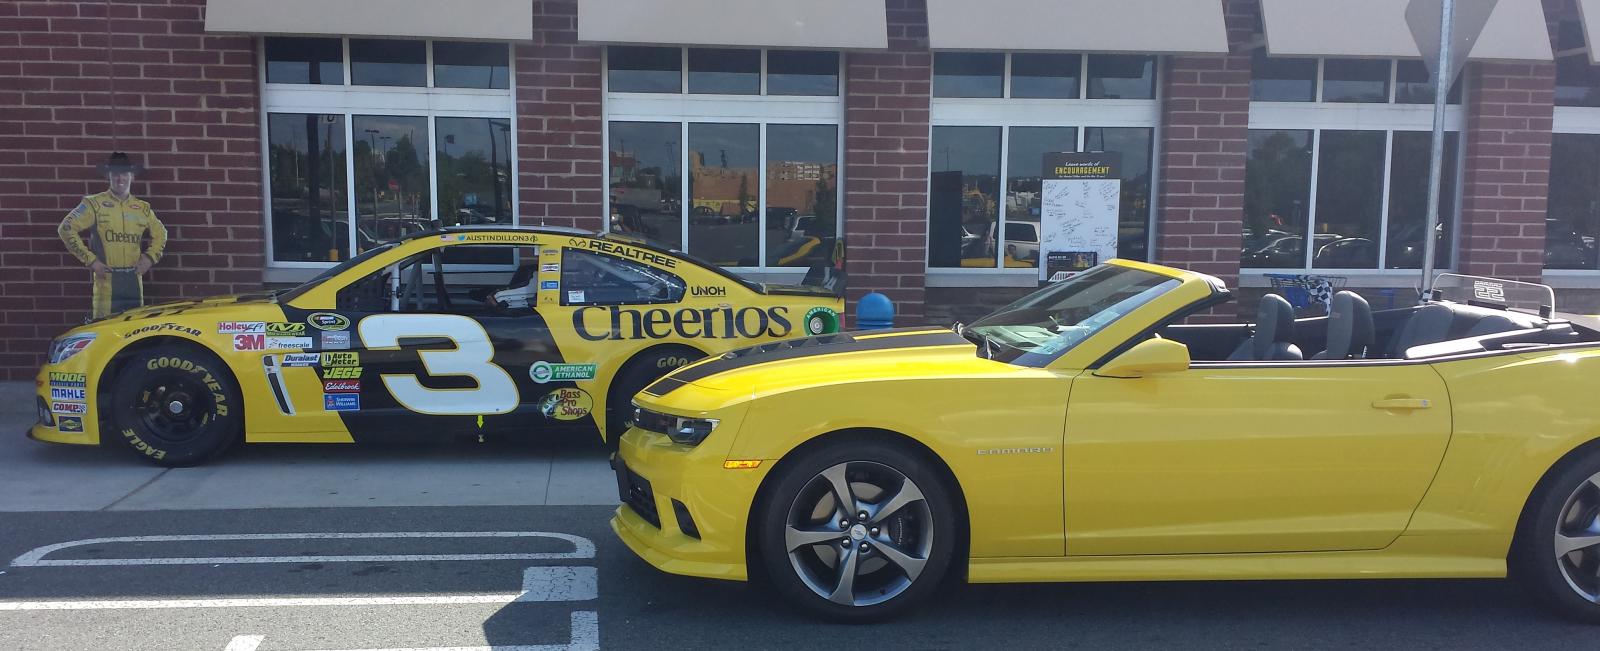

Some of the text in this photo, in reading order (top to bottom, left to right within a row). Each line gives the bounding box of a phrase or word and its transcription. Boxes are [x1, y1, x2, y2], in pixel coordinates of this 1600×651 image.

[1055, 166, 1110, 174] ENCOURAGEMENT
[589, 240, 677, 268] REALTREE
[691, 286, 726, 296] UNOH
[806, 306, 836, 319] AMERICAN
[219, 322, 249, 332] Holley
[572, 304, 793, 342] Cheerios
[234, 334, 265, 350] 3M
[284, 354, 318, 362] Duralast
[358, 313, 521, 416] 3
[50, 372, 86, 382] MOOG
[323, 367, 363, 379] JEGS
[325, 382, 360, 390] Edelbrock
[51, 388, 85, 399] MAHLE
[559, 389, 581, 399] Bass
[561, 397, 577, 407] Pro
[560, 406, 587, 417] Shops
[122, 428, 166, 460] EAGLE
